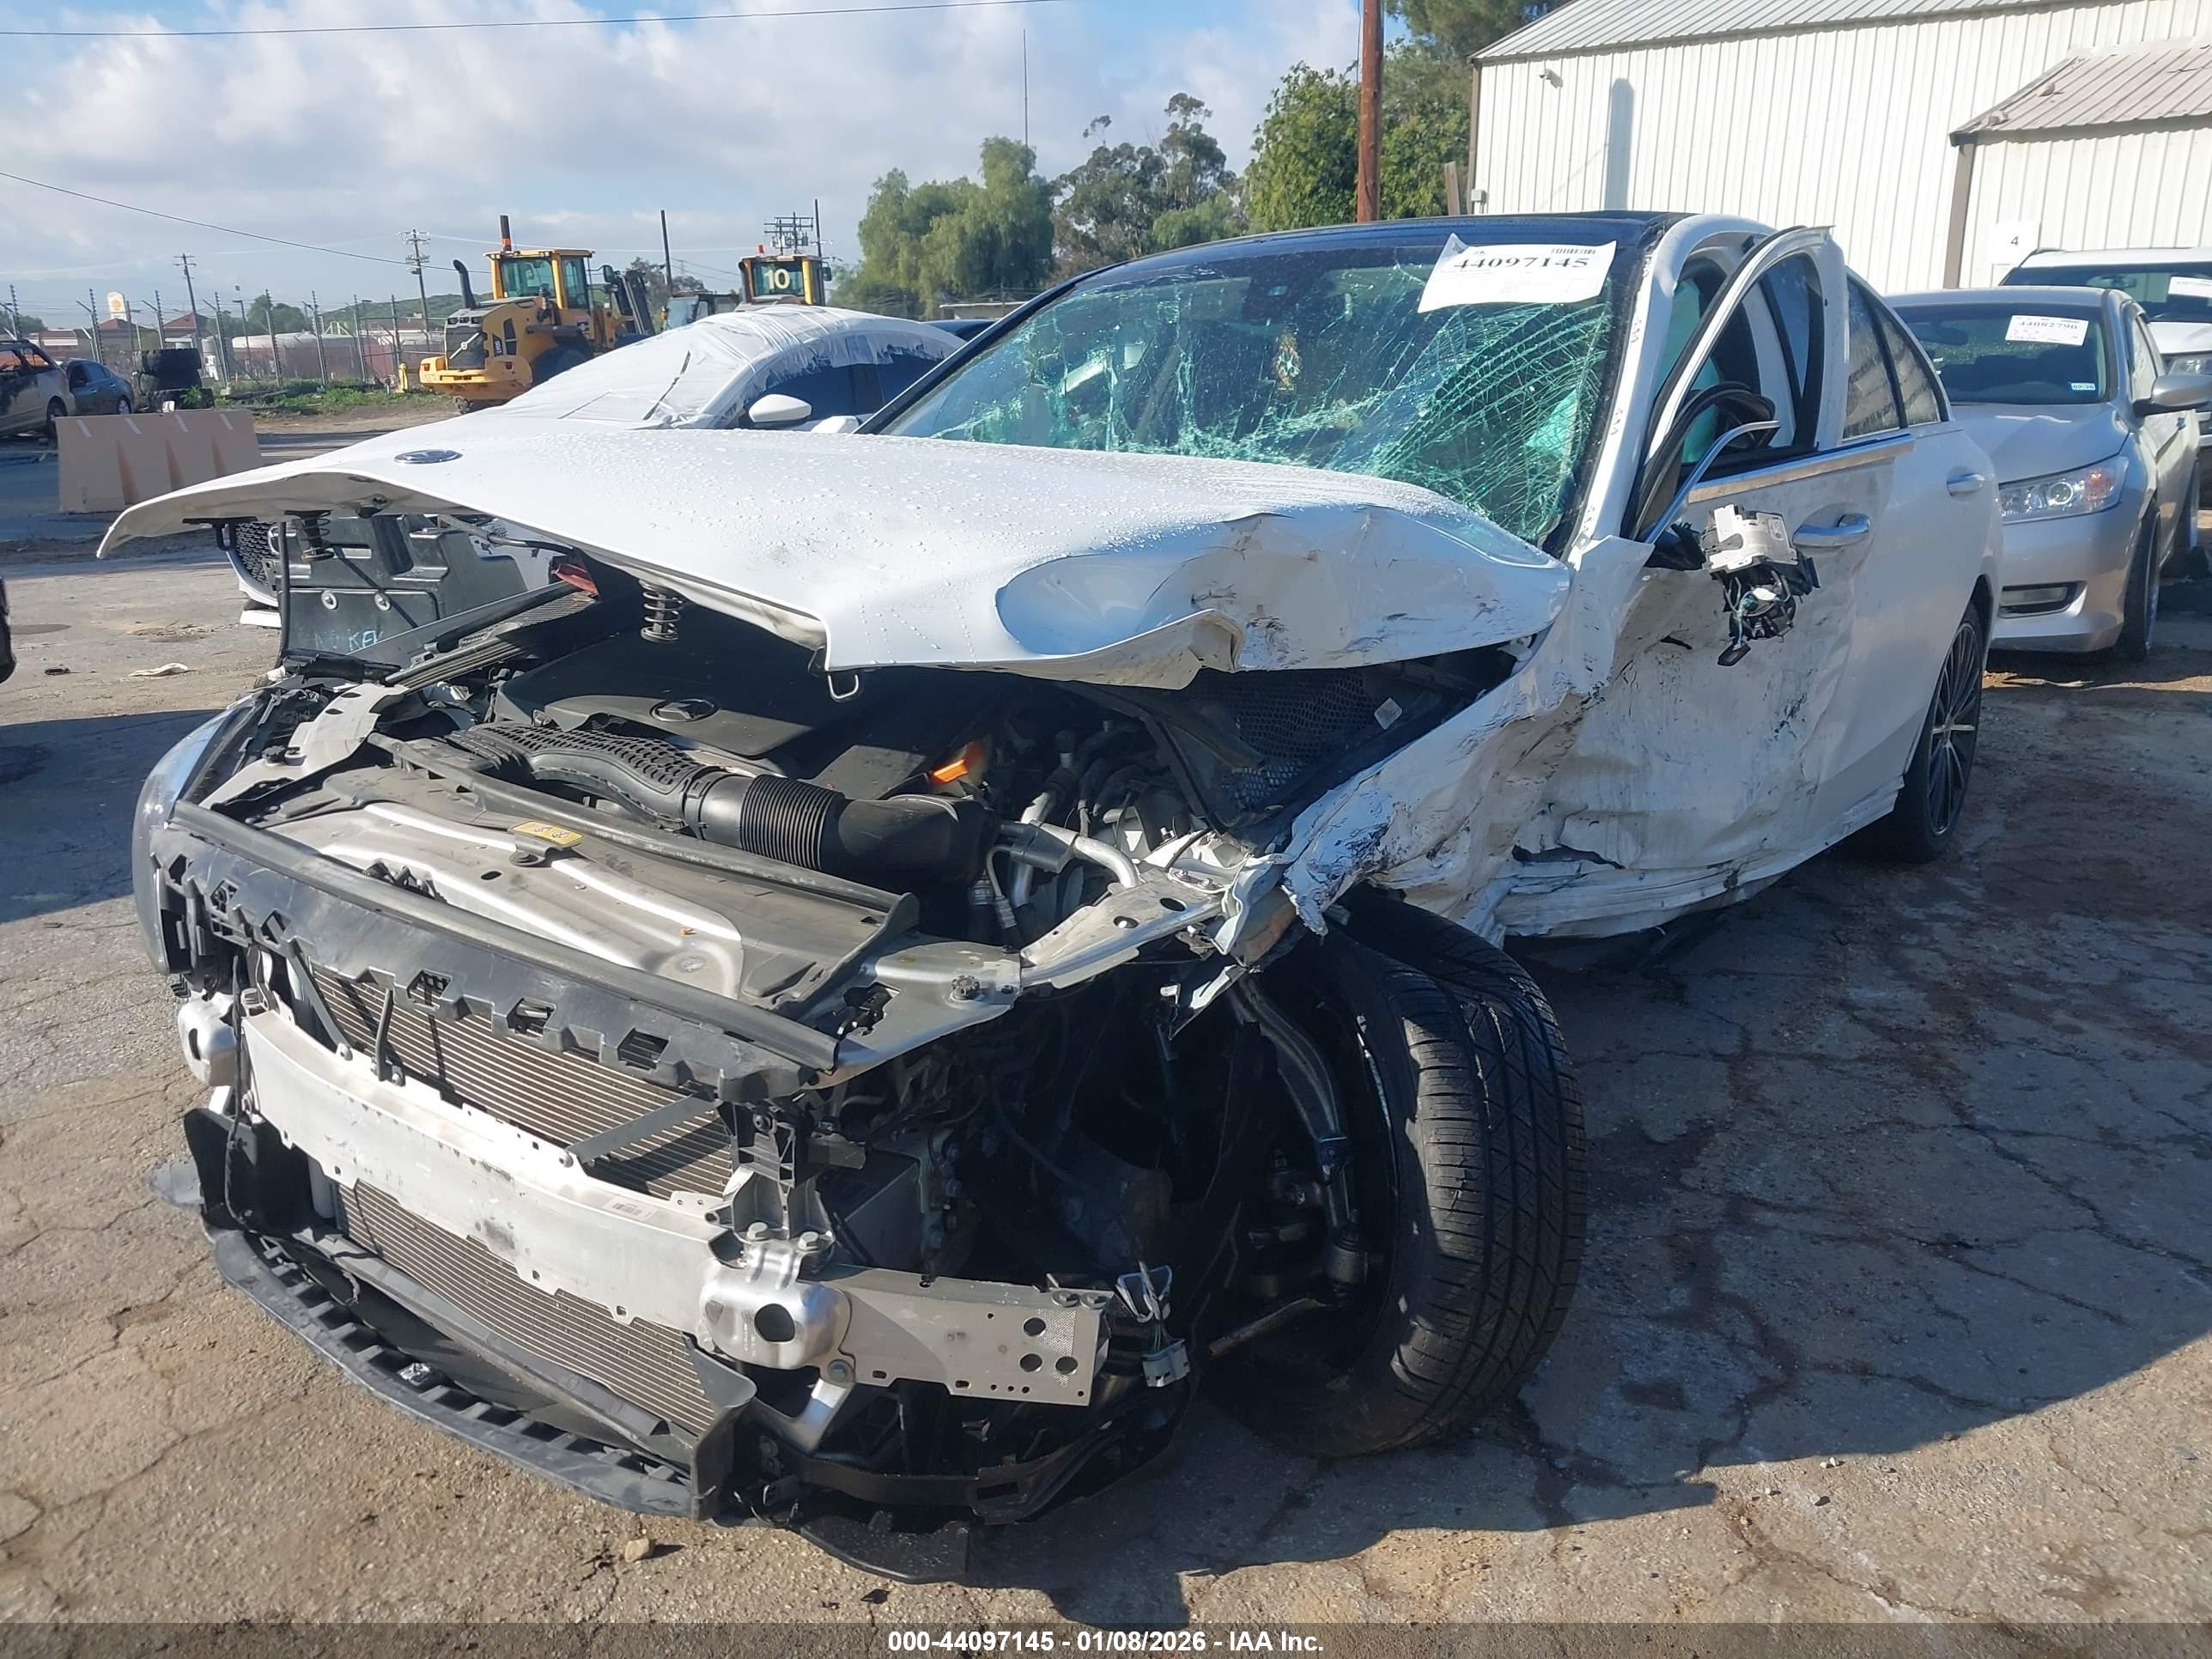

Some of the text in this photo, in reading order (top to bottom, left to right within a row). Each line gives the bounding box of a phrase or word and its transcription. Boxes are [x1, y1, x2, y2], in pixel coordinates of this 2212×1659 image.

[2010, 236, 2019, 246] 4
[1453, 257, 1590, 270] 44097145
[763, 268, 791, 289] 10
